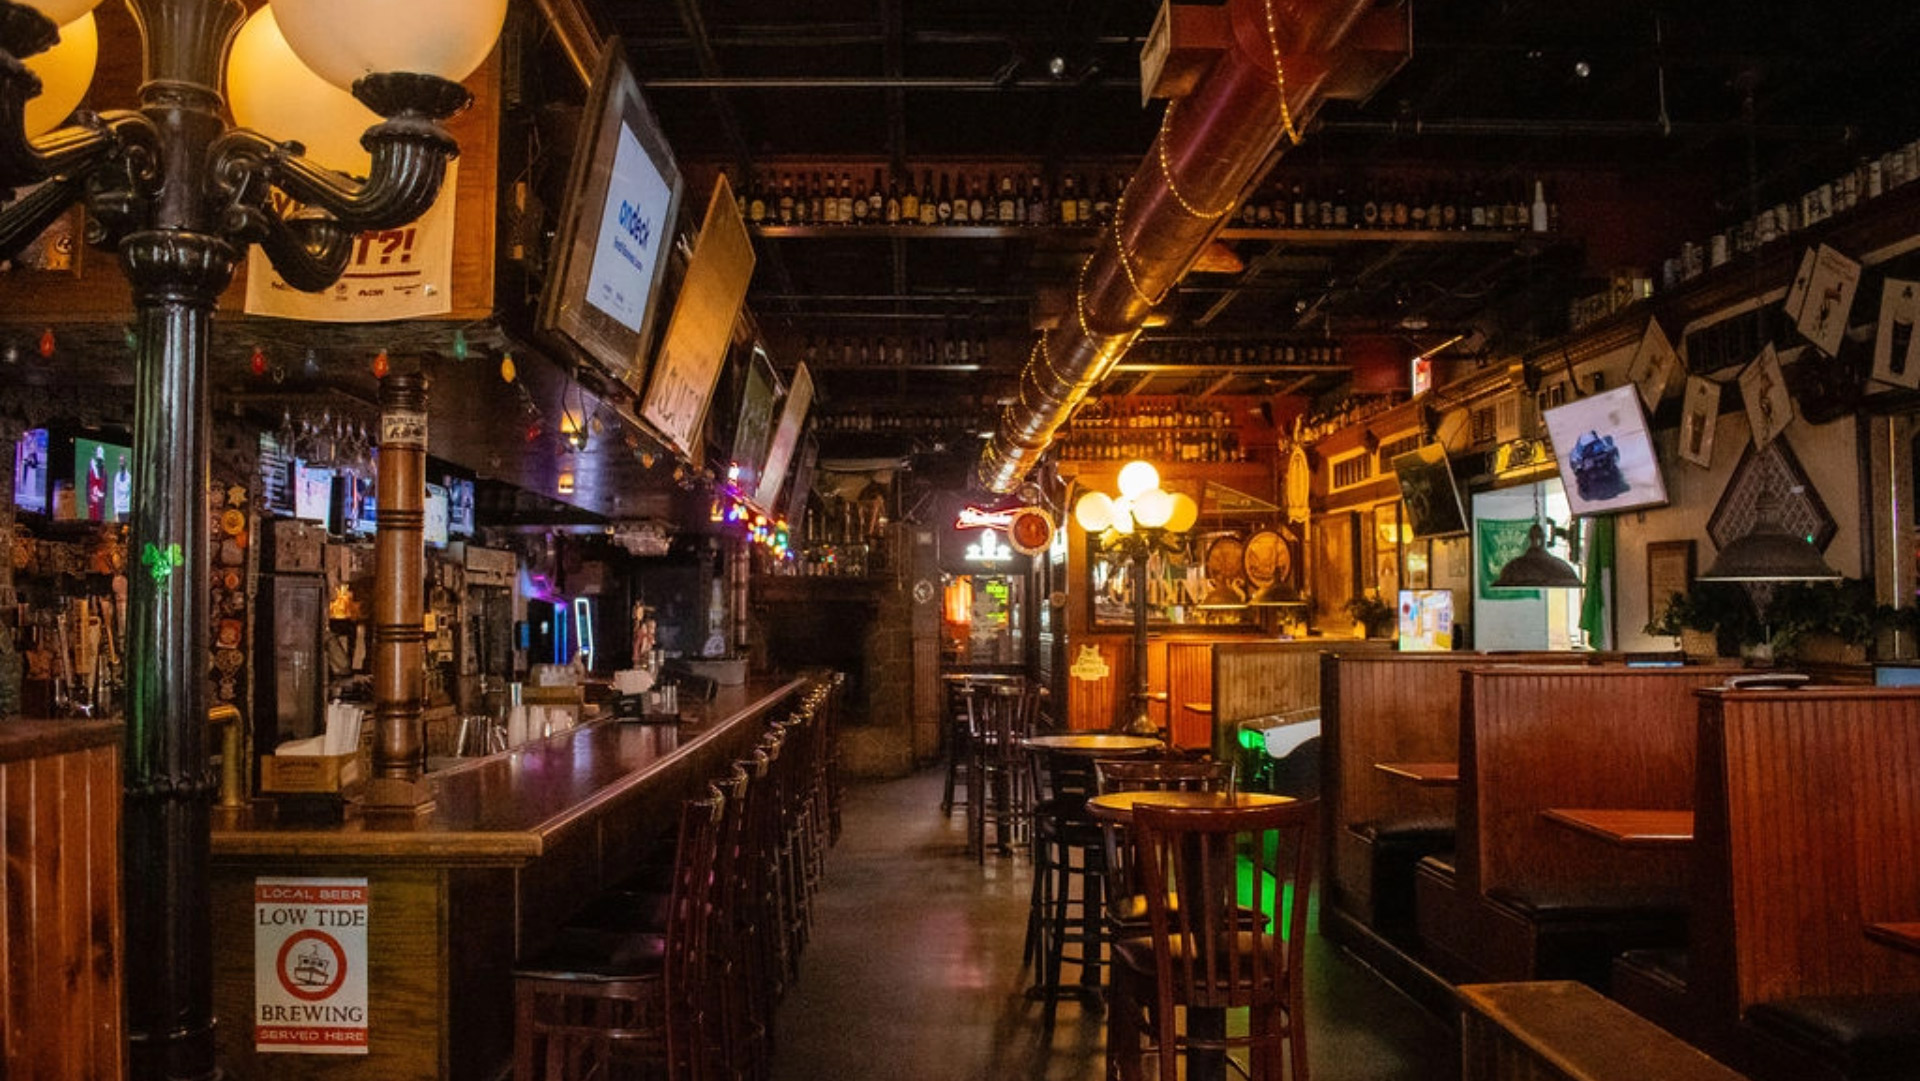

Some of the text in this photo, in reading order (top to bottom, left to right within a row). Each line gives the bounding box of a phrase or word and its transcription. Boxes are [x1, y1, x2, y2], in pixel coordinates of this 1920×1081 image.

[618, 199, 651, 251] ondeck
[354, 228, 417, 265] T?!
[262, 888, 361, 899] LOCAL BEER
[259, 908, 365, 927] LOW TIDE
[261, 1004, 363, 1022] BREWING
[260, 1030, 364, 1041] SERVED HERE
